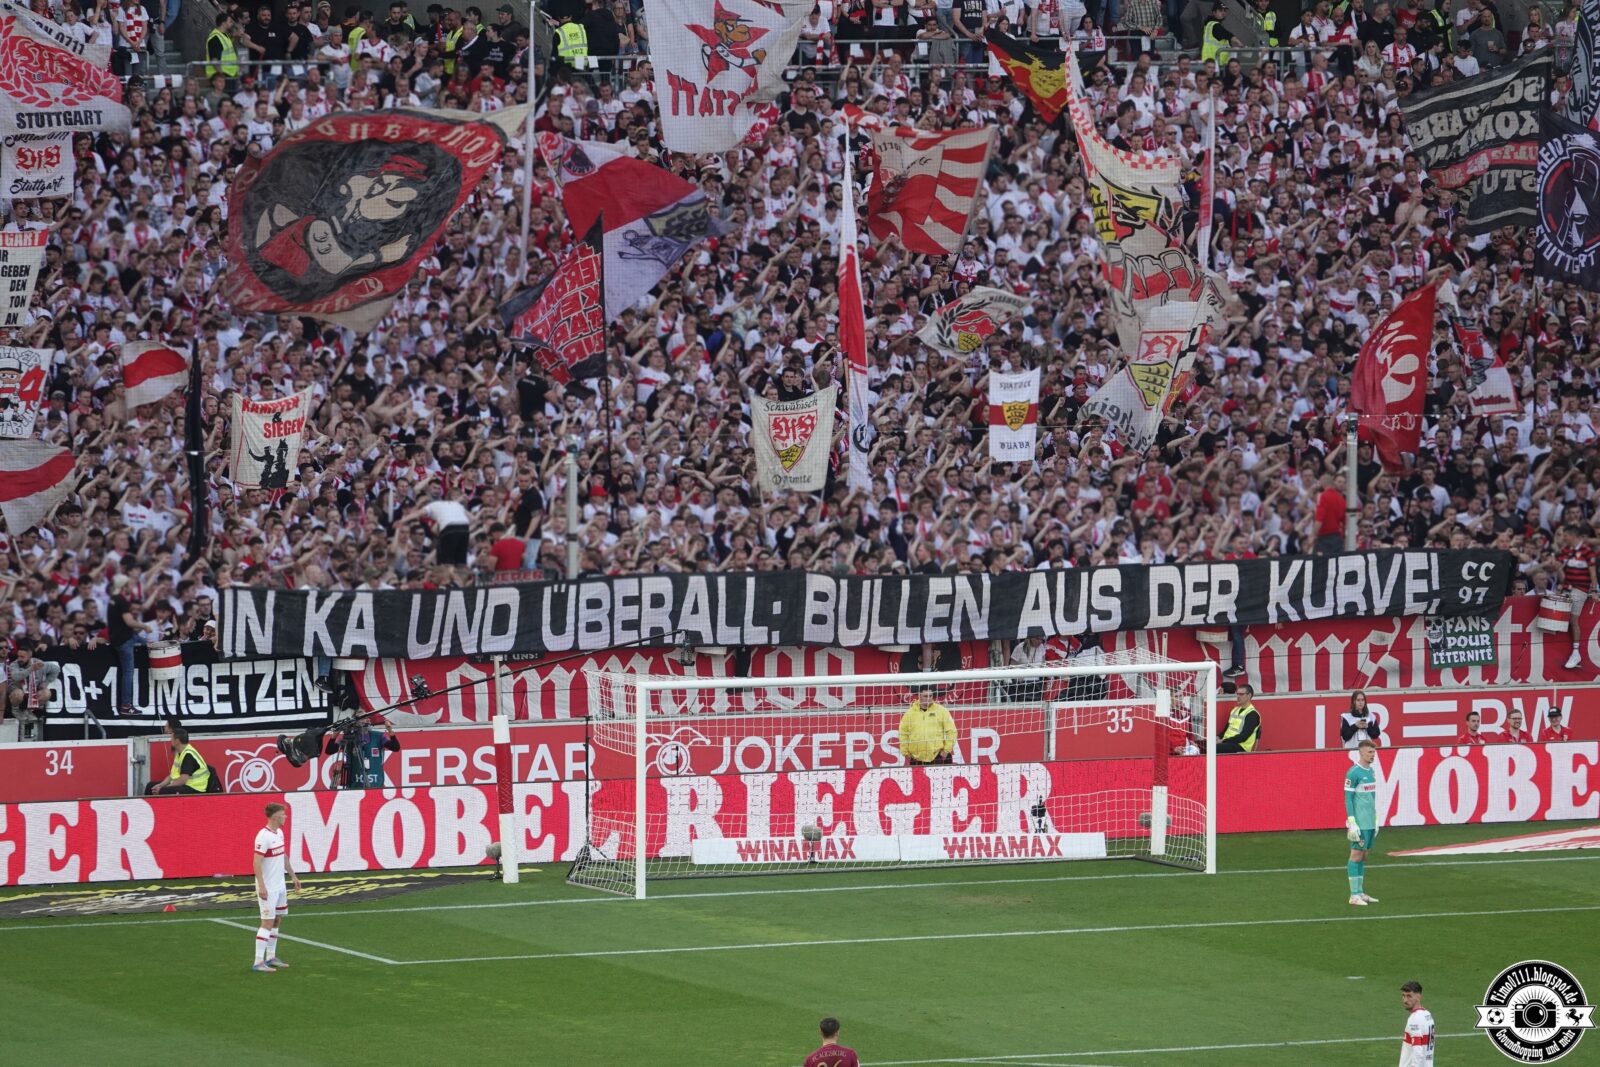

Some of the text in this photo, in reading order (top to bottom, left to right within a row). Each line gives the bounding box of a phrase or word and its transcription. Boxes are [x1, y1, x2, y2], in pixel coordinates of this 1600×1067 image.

[16, 110, 103, 129] STUTTGART
[10, 176, 65, 197] Stuttgart
[0, 231, 40, 247] GART
[1, 265, 31, 277] GEBEN
[10, 279, 27, 292] DEN
[10, 296, 27, 308] TON
[5, 313, 19, 325] AN
[263, 417, 305, 438] SIEGEN
[1461, 561, 1496, 582] CC
[1458, 586, 1490, 605] 97
[223, 589, 275, 658] IN
[303, 590, 379, 658] KA
[407, 586, 520, 660] UND
[803, 572, 991, 646] BULLEN
[1017, 568, 1122, 640] AUS
[1144, 563, 1240, 629] DER
[1445, 616, 1490, 633] FANS
[1446, 634, 1491, 649] POUR
[1433, 646, 1493, 665] L'ÉTERNITÉ
[132, 657, 328, 716] UMSETZEN
[1107, 708, 1134, 734] 35
[711, 727, 1000, 776] JOKERSAR
[45, 750, 74, 776] 34
[0, 797, 163, 886] ER
[659, 763, 1059, 858] RIEGER
[736, 835, 1063, 861] WINAMAX WINAMAX
